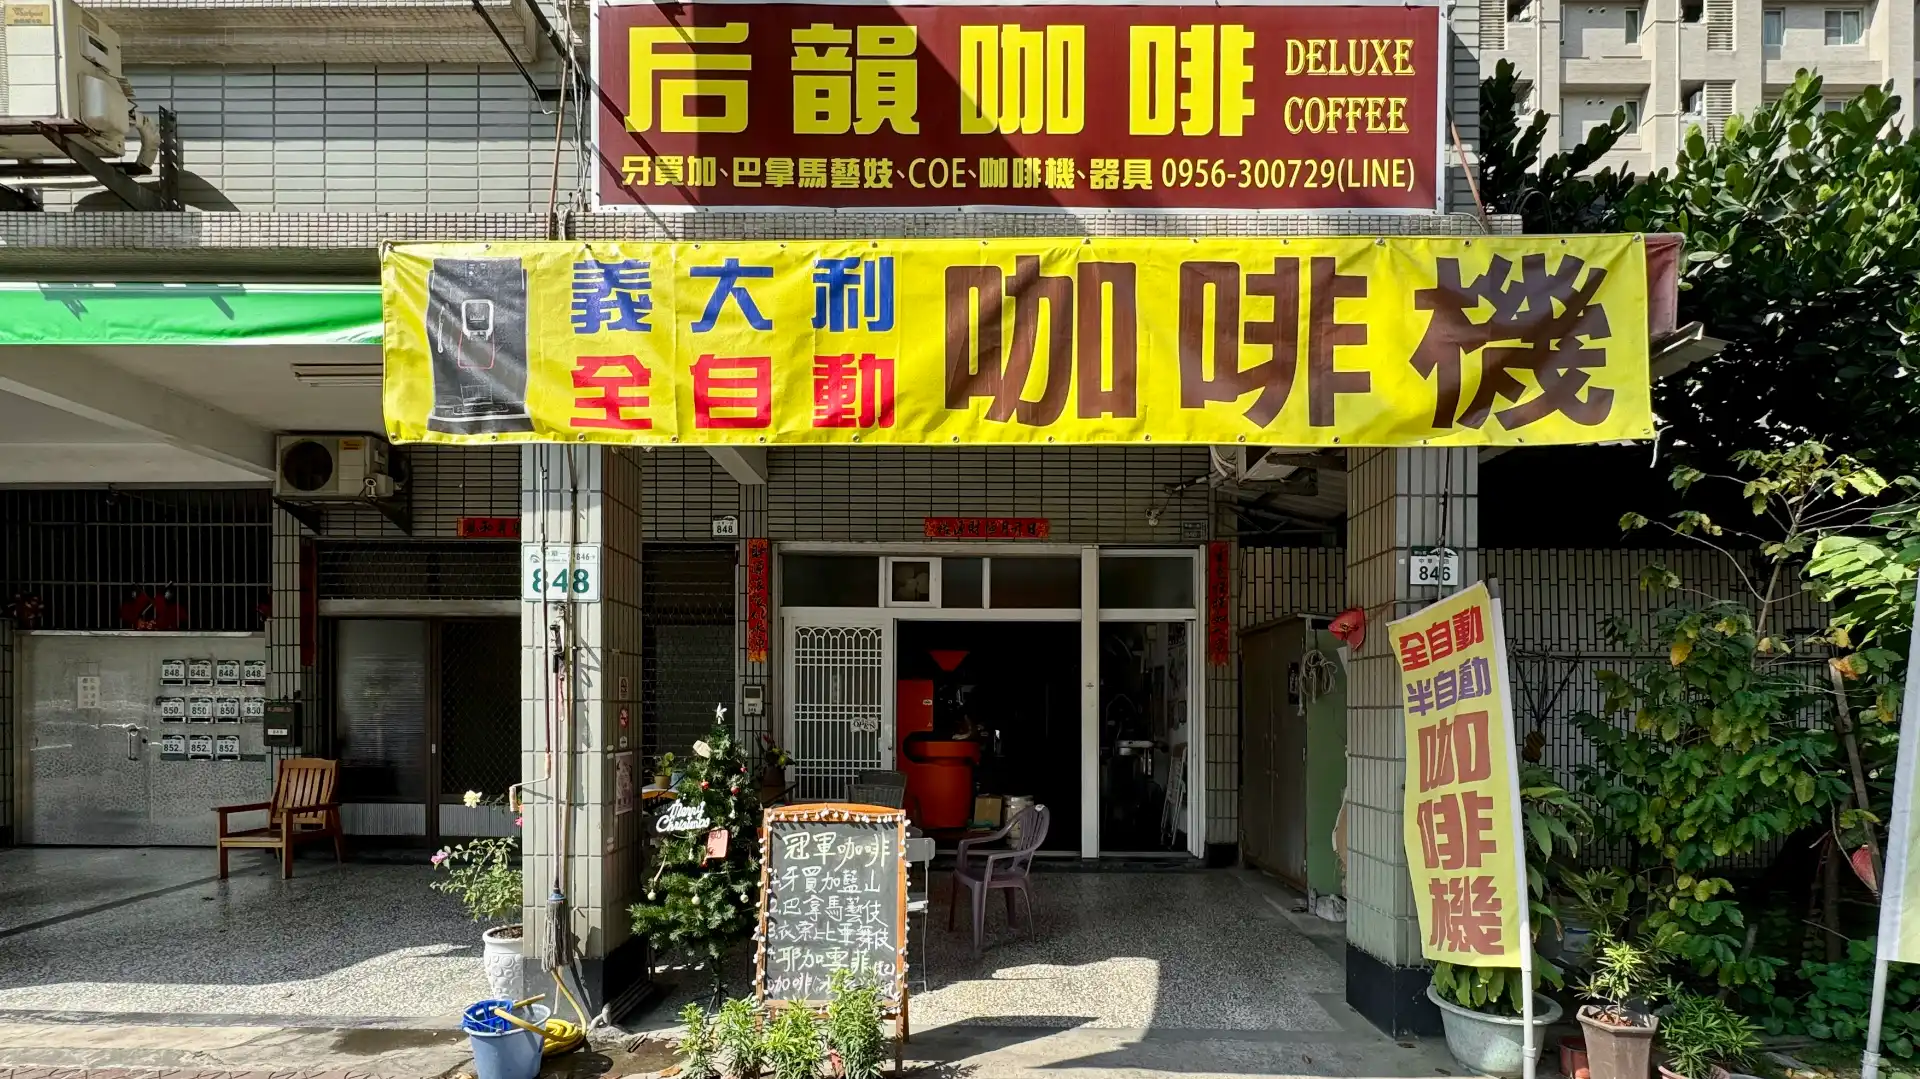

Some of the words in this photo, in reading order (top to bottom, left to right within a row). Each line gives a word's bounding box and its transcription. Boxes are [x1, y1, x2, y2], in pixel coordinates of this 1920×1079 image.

[1285, 38, 1416, 76] DELUXE
[624, 22, 1256, 137] 后韻咖啡
[1283, 96, 1410, 135] COFFEE
[1161, 158, 1416, 193] 0956-300729(LINE)
[570, 256, 897, 335] 義大利
[944, 253, 1615, 430] 咖啡機
[570, 353, 897, 430] 全自動
[717, 525, 733, 534] 848
[532, 568, 590, 594] 848
[1419, 566, 1451, 581] 846
[1399, 604, 1485, 672] 全自動
[164, 669, 180, 677] 848
[190, 669, 206, 677] 848
[218, 669, 234, 677] 848
[245, 669, 261, 678] 848
[1406, 656, 1493, 717] 半自動
[163, 706, 179, 714] 850
[191, 706, 207, 715] 850
[220, 706, 235, 715] 850
[246, 706, 261, 715] 850
[163, 743, 179, 752] 852
[190, 743, 207, 752] 852
[218, 743, 234, 752] 852
[1416, 710, 1505, 956] 咖啡機
[782, 831, 891, 873] 冠軍咖啡
